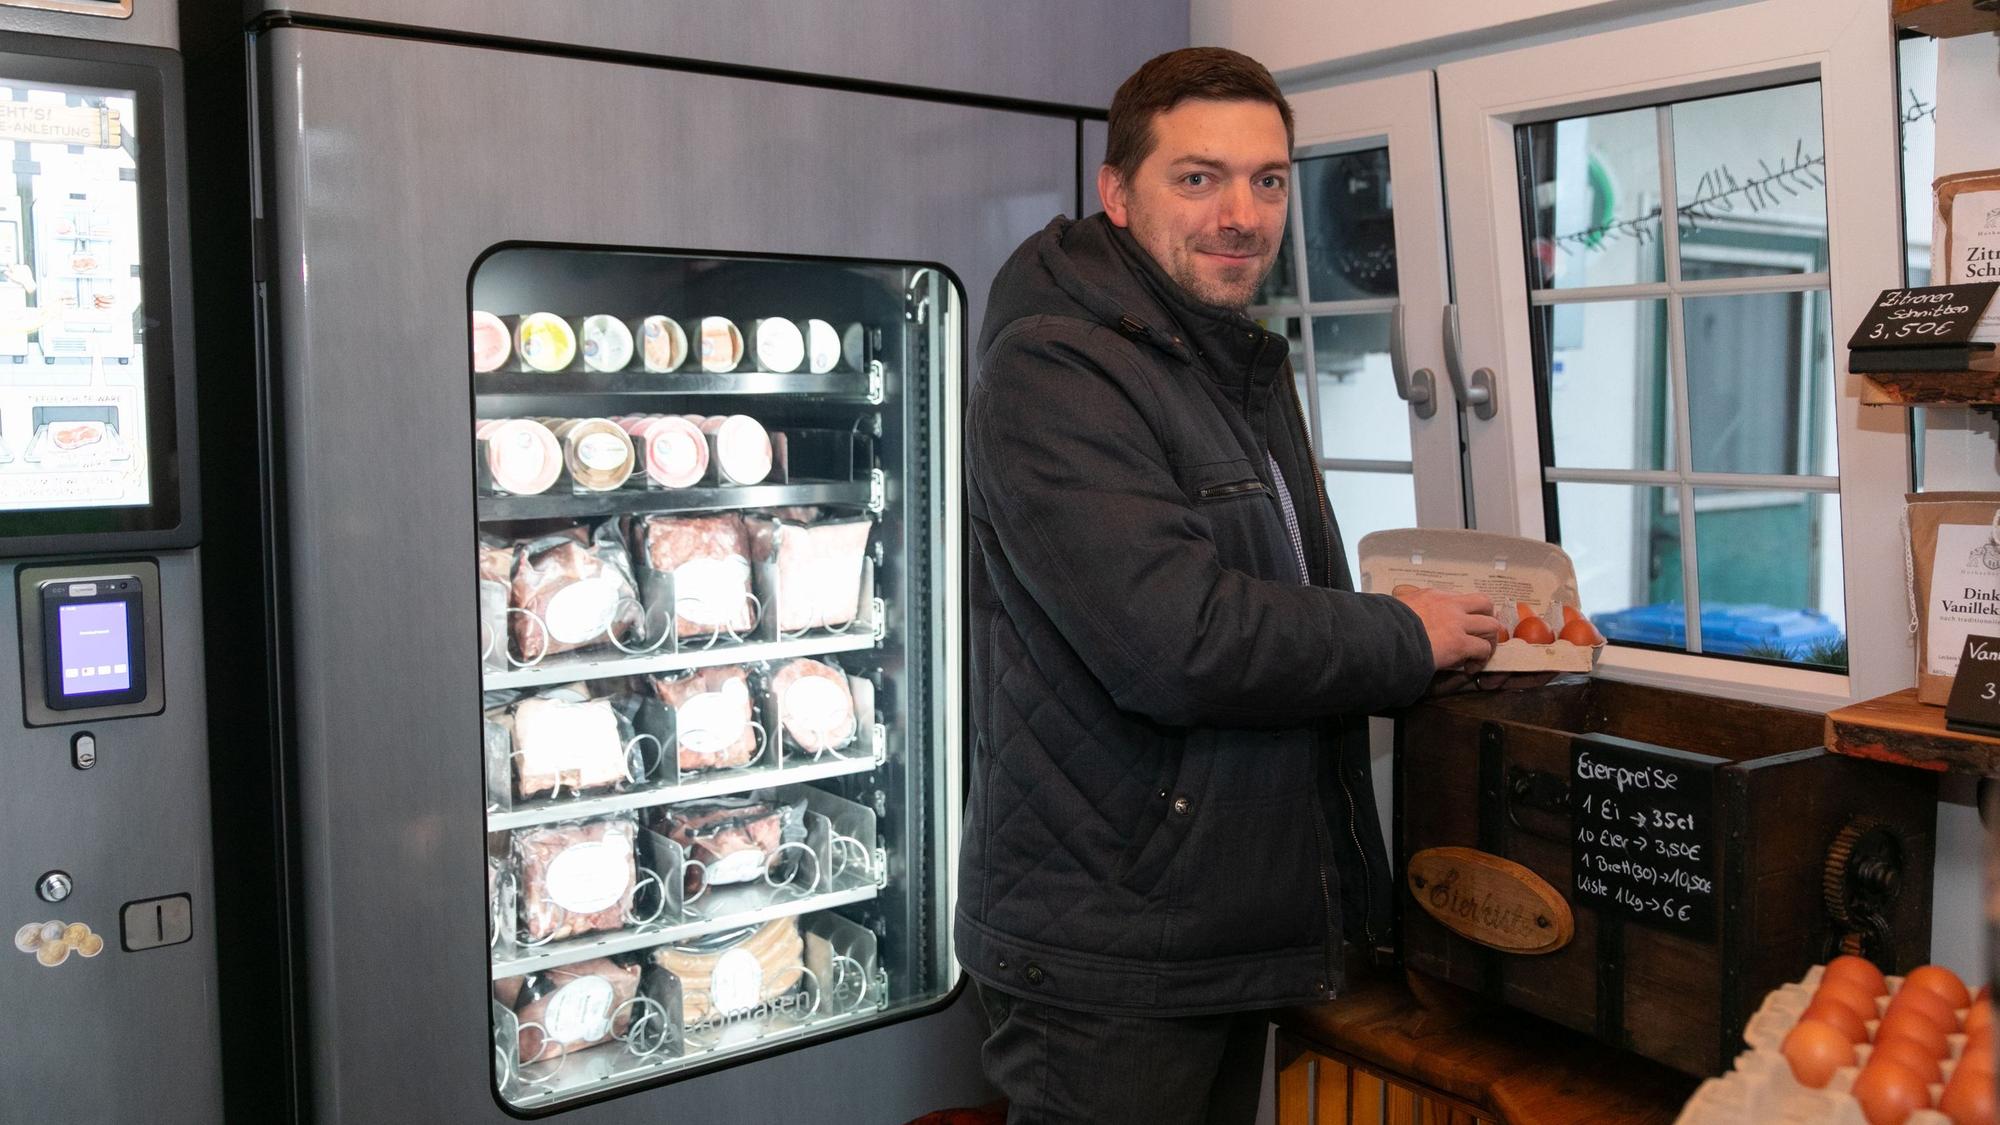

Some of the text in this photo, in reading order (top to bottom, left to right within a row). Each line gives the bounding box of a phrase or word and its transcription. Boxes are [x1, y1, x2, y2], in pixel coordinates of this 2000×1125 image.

[1966, 261, 2000, 277] Sch
[1880, 291, 1954, 307] Zitronen
[1887, 304, 1969, 320] Schnitten
[1869, 321, 1955, 339] 3,50€
[1577, 752, 1678, 792] Eierpreise
[1582, 794, 1694, 831] 1 Ei 35ct
[1578, 827, 1701, 861] 10 Eier 3,50€
[1581, 853, 1590, 867] 1
